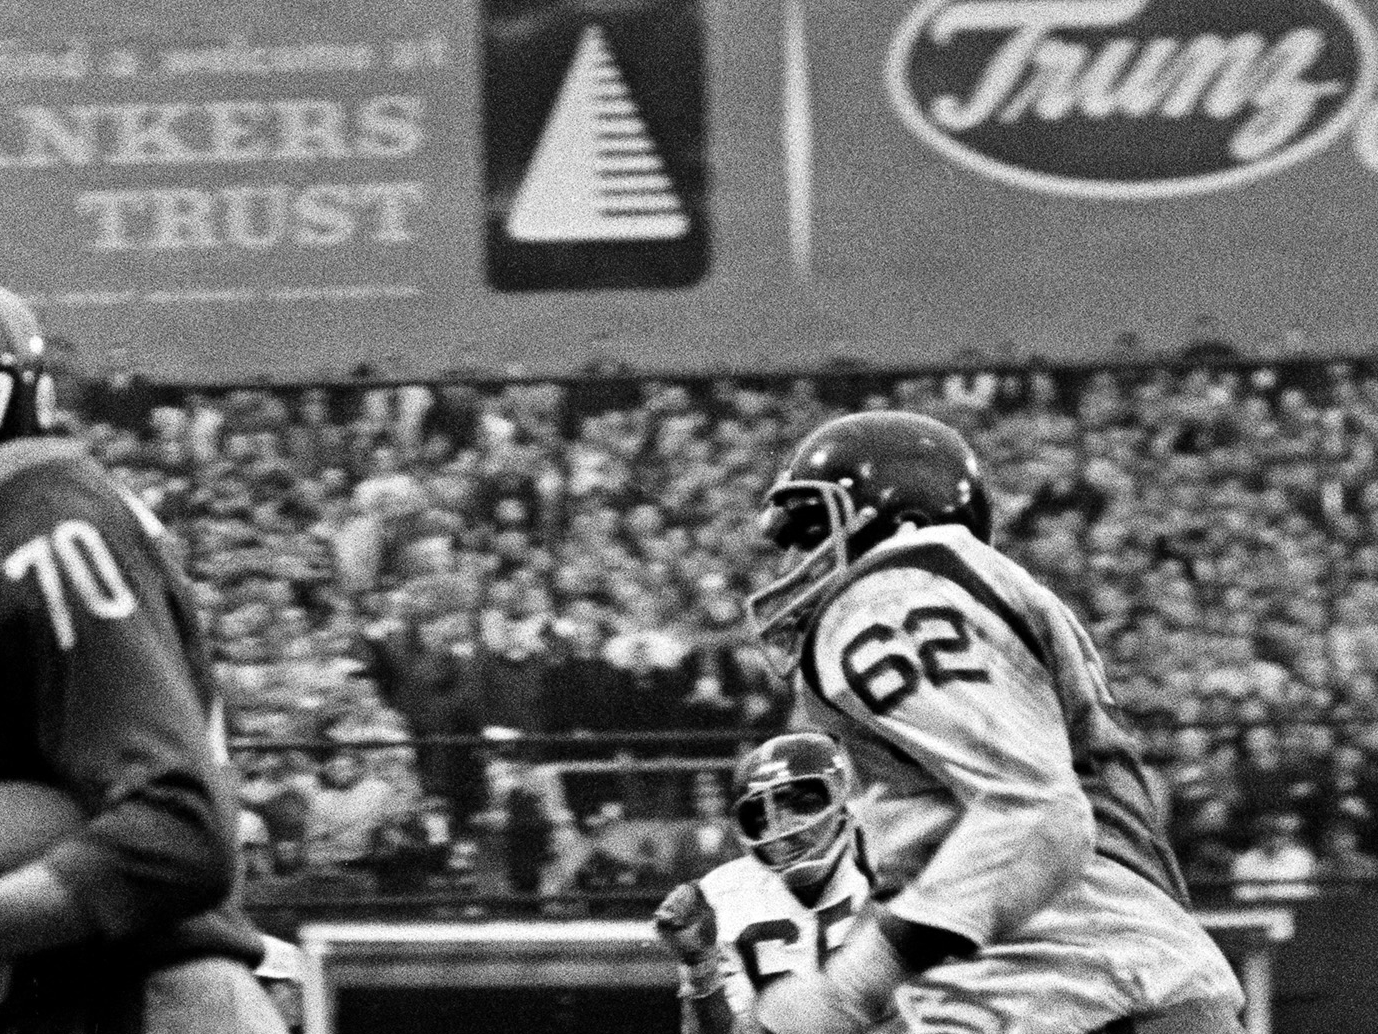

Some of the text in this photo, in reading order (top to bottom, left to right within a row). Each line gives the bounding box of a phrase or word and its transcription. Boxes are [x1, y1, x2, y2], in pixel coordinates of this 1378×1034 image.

[77, 182, 423, 250] TRUST
[4, 520, 136, 649] 70
[841, 605, 990, 714] 62
